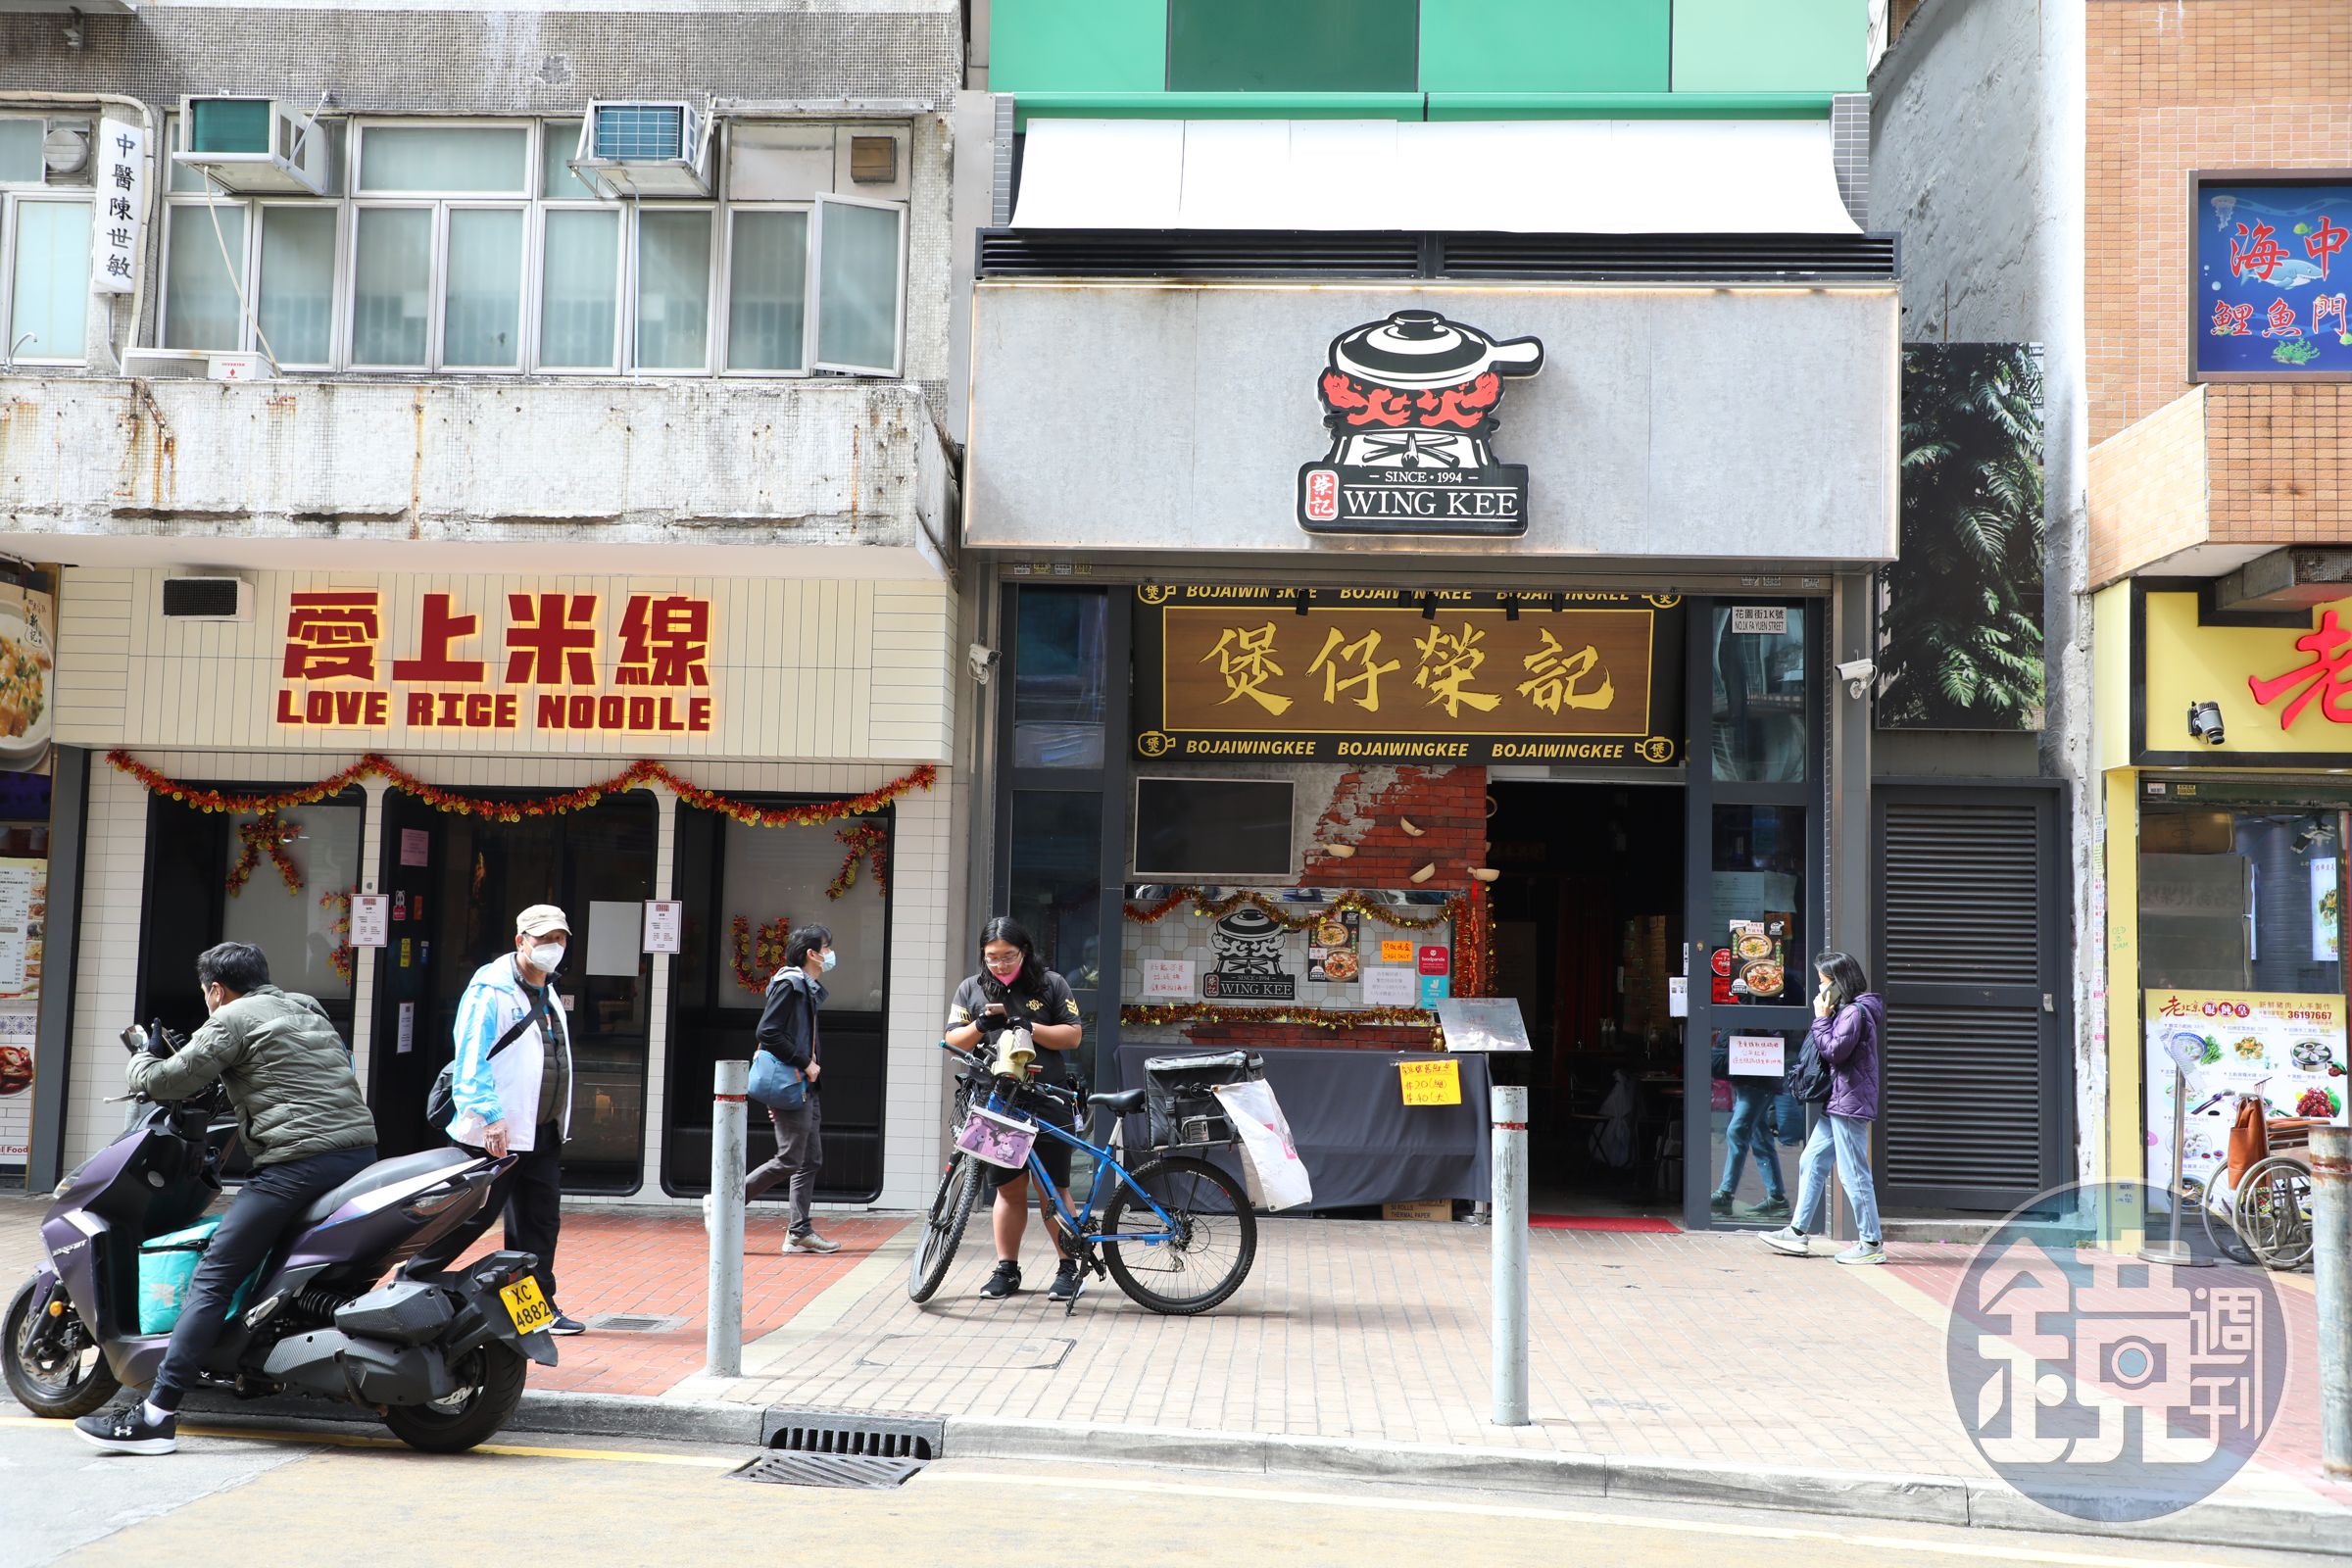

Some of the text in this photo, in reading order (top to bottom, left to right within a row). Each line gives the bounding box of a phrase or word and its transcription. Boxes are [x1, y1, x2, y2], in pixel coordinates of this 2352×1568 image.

[106, 133, 135, 279] 中醫陳世敏
[2211, 297, 2348, 337] 鯉魚門
[1385, 470, 1463, 484] SINCE 1994
[1344, 491, 1519, 516] WING KEE
[1736, 609, 1784, 619] 花園街1K號
[1748, 621, 1755, 631] FA
[1755, 621, 1768, 631] YUEN
[1768, 621, 1784, 631] STREET
[283, 592, 710, 686] 愛上米線
[1200, 621, 1616, 718] 煲仔榮記
[2247, 609, 2352, 731] 老
[277, 690, 710, 731] LOVE RICE NOODLE
[1186, 740, 1625, 759] BOJAIWINGKEE BOJAIWINGKEE BOJAIWINGKEE
[1221, 983, 1293, 995] WING KEE
[2159, 996, 2201, 1017] 老北京
[2287, 1010, 2332, 1020] 36197667
[2298, 1002, 2331, 1010] 人手製作
[511, 1285, 532, 1305] XC
[515, 1300, 551, 1328] 4882
